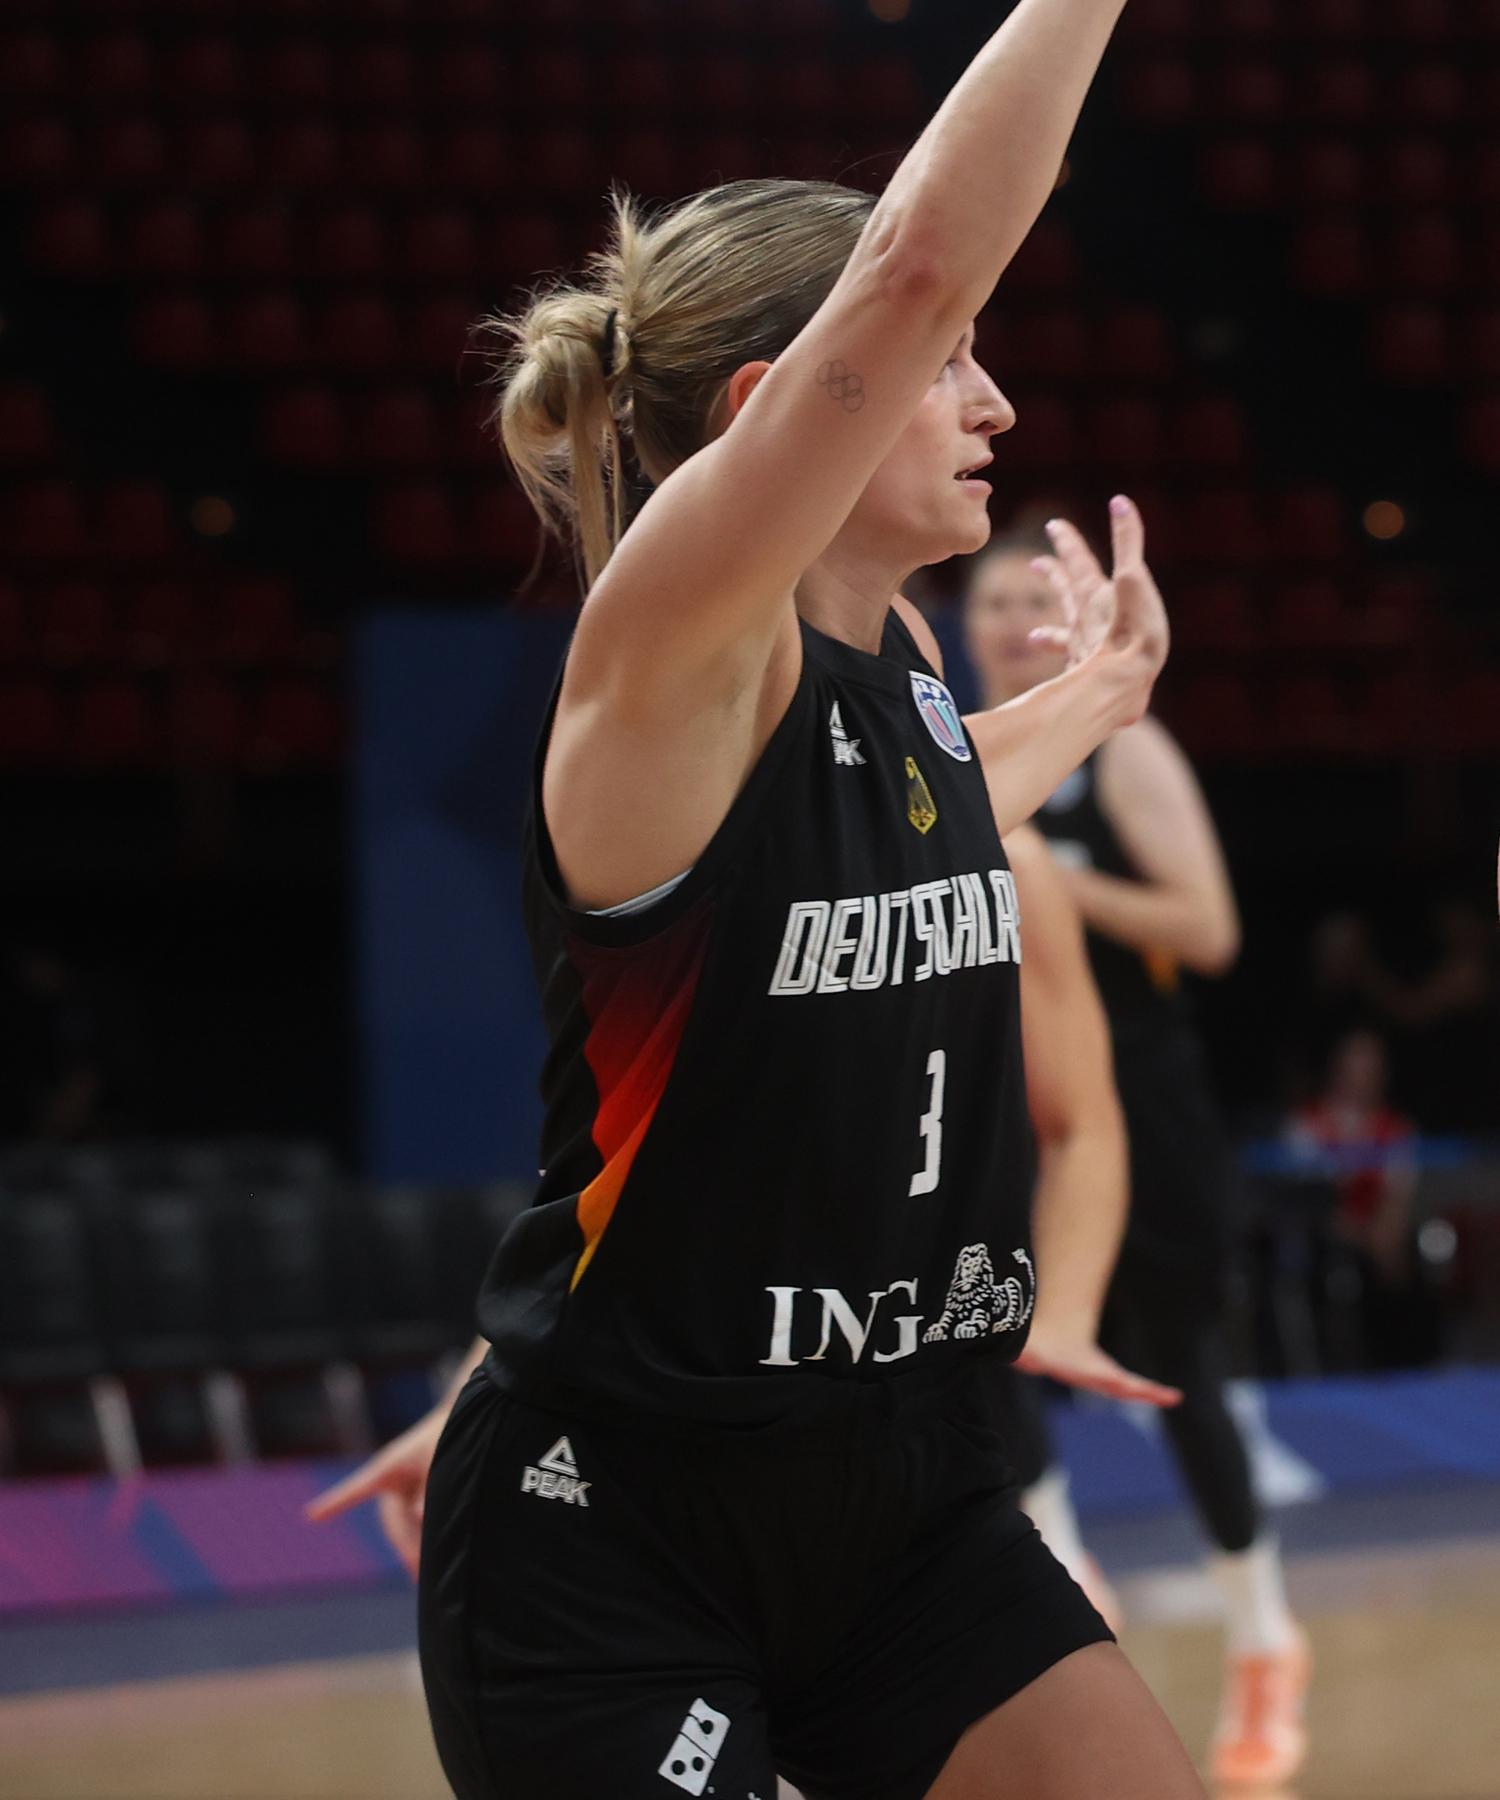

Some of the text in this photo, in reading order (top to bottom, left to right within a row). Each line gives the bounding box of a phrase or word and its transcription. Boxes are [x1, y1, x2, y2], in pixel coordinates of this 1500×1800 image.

[768, 869, 1022, 996] DEUTSCHLA
[908, 1049, 946, 1197] 3
[758, 1278, 925, 1366] ING
[521, 1465, 592, 1507] PEAK
